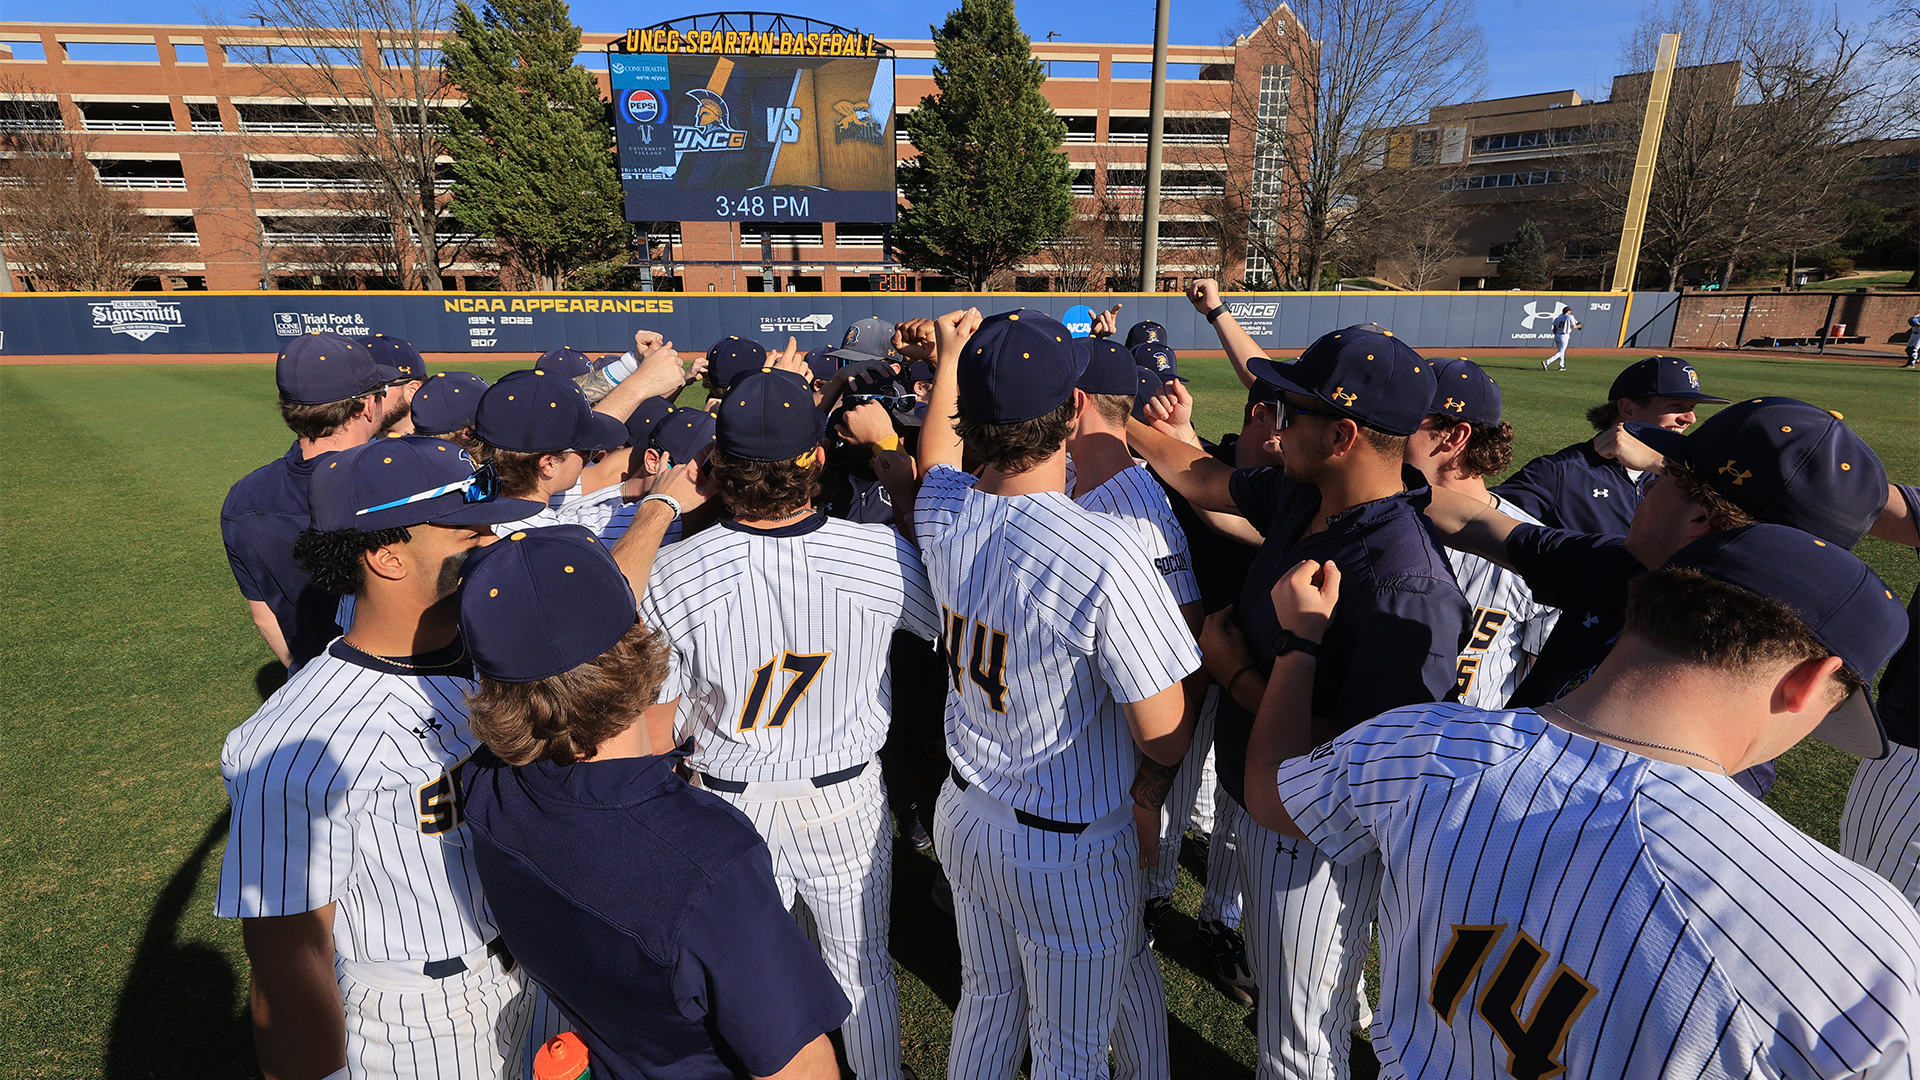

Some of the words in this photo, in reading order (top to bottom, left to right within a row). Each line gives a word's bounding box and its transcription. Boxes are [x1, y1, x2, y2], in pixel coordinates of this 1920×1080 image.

[626, 28, 680, 53] UNCG
[686, 30, 775, 55] SPARTAN
[779, 32, 877, 57] BASEBALL
[767, 107, 801, 143] VS
[621, 172, 673, 180] STEEL
[716, 195, 765, 217] 3:48
[772, 196, 809, 217] PM
[444, 299, 507, 313] NCAA
[510, 299, 674, 313] APPEARANCES
[1230, 304, 1278, 317] UNCG
[1589, 302, 1612, 311] 340
[92, 305, 183, 325] Signsmith
[301, 313, 328, 325] Triad
[329, 313, 353, 325] Foot
[354, 313, 364, 325] &
[467, 316, 495, 325] 1994
[500, 316, 533, 325] 2022
[335, 325, 370, 336] Center
[469, 328, 497, 336] 1997
[760, 323, 828, 332] STEEL
[1066, 322, 1092, 333] NCA
[470, 338, 498, 347] 2017
[941, 602, 1010, 715] 44
[736, 649, 832, 734] 17
[1428, 923, 1599, 1080] 14
